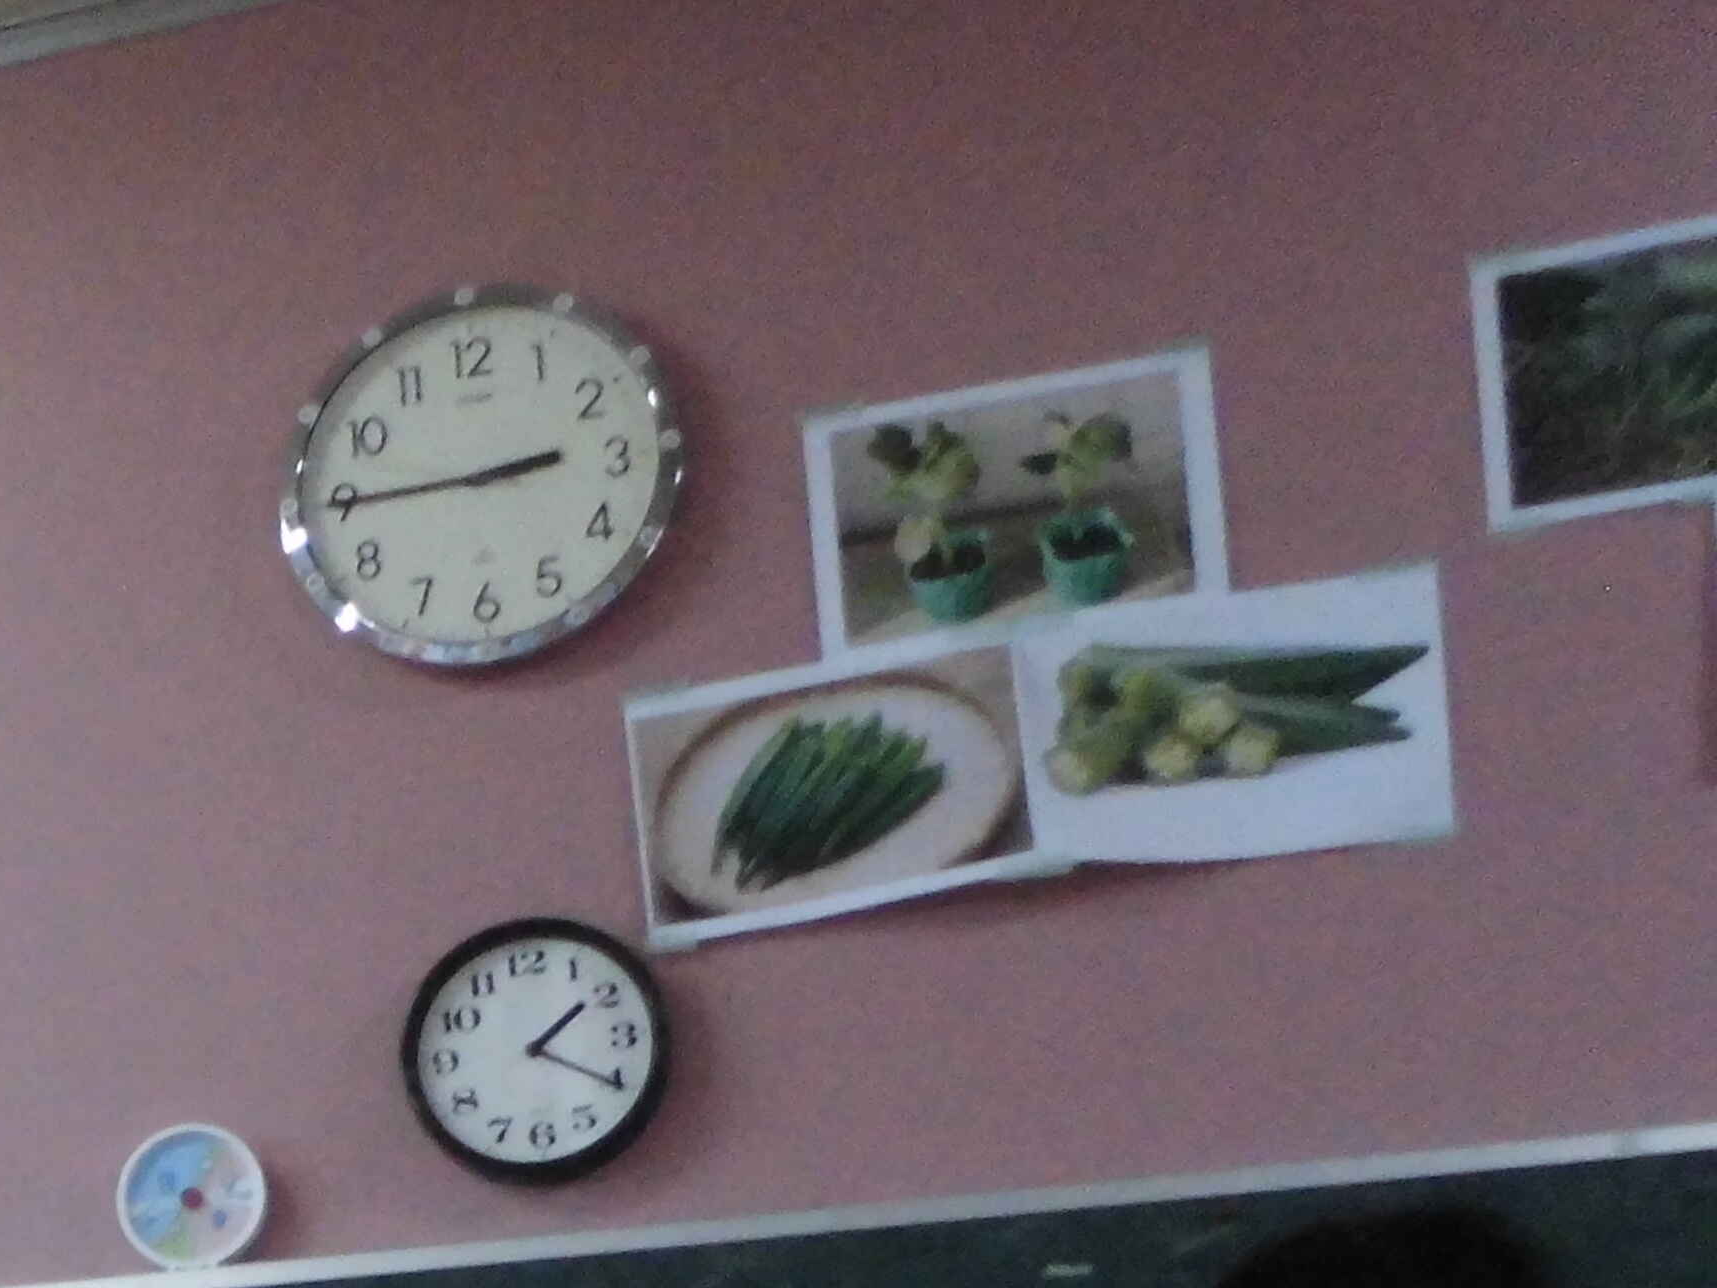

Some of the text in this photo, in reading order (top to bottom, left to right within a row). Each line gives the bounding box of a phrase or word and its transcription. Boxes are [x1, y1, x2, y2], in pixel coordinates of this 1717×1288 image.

[451, 336, 493, 378] 12
[533, 344, 545, 382] 1
[397, 365, 422, 407] 11
[575, 377, 604, 421] 2
[348, 416, 388, 458] 10
[605, 436, 632, 478] 3
[586, 502, 614, 541] 4
[355, 539, 382, 581] 8
[536, 556, 563, 598] 5
[412, 577, 435, 616] 7
[473, 581, 501, 624] 6
[506, 950, 547, 977] 12
[566, 955, 580, 981] 1
[468, 971, 496, 997] 11
[593, 981, 619, 1008] 2
[441, 1008, 481, 1034] 10
[610, 1023, 638, 1050] 3
[431, 1049, 460, 1075] 9
[488, 1117, 512, 1143] 7
[528, 1122, 557, 1150] 6
[571, 1105, 597, 1133] 5
